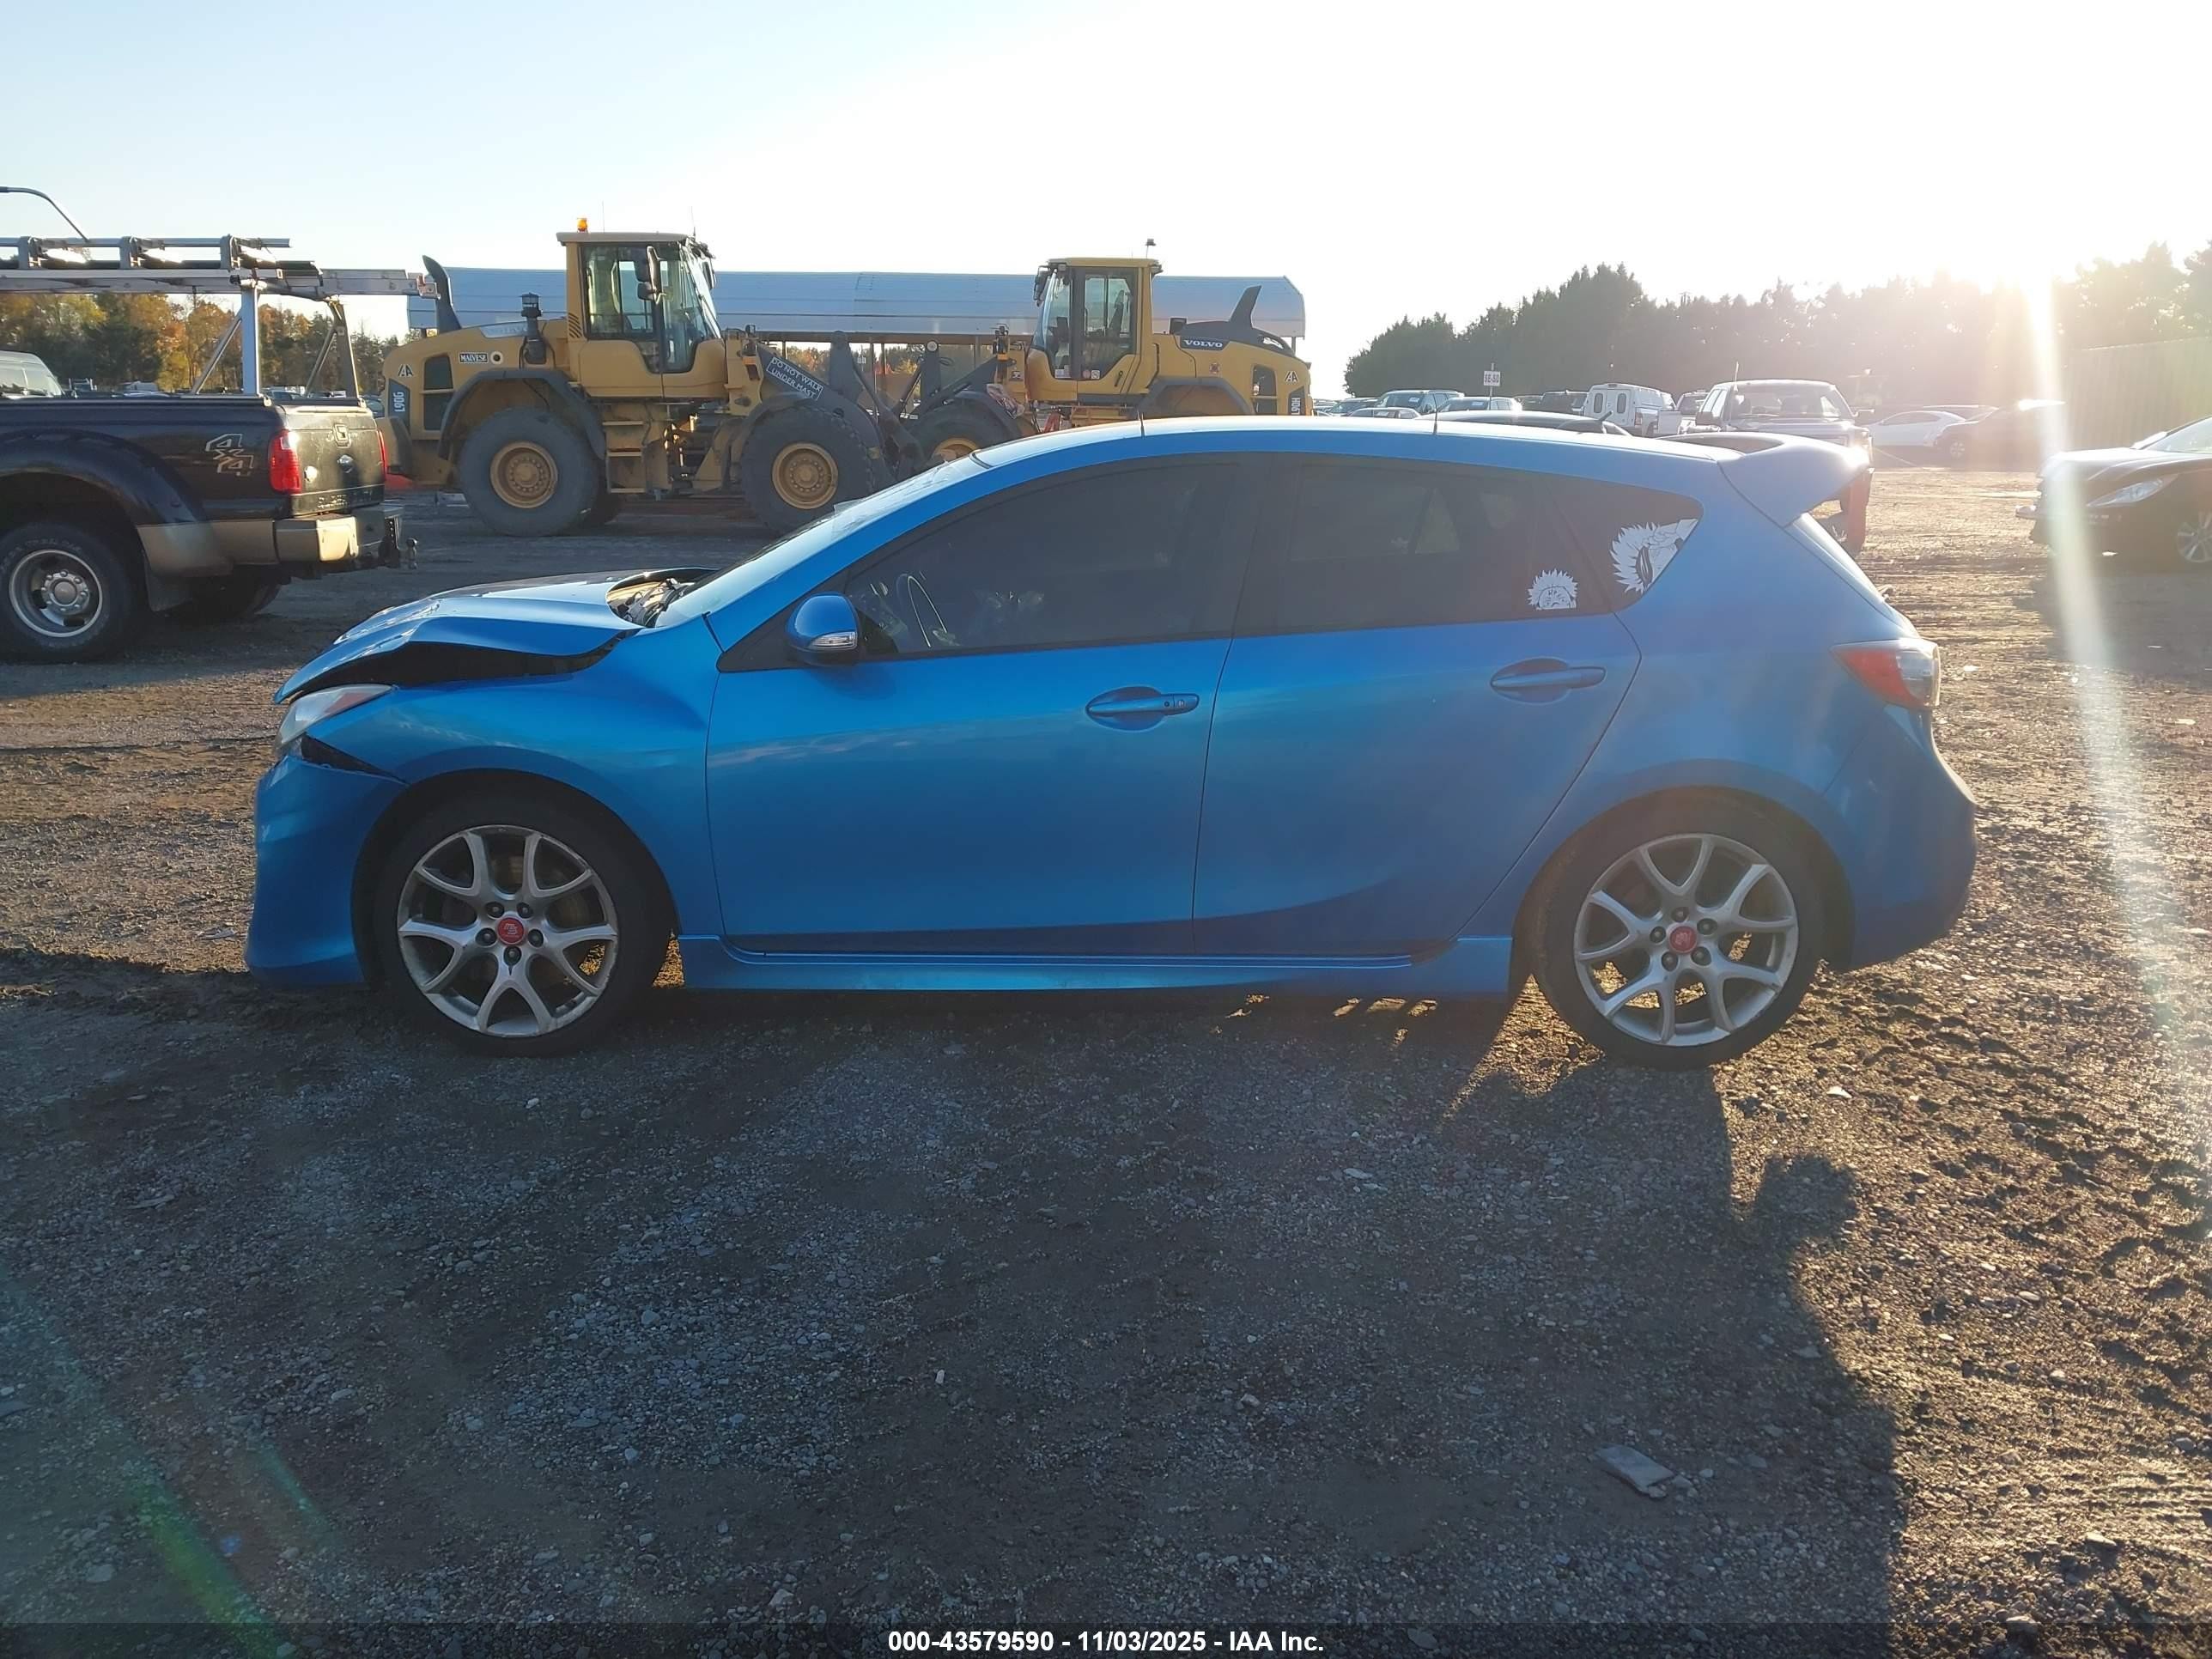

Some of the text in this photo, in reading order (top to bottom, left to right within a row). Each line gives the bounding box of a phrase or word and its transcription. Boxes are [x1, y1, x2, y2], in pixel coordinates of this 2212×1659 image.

[1183, 339, 1223, 348] VOLVO
[772, 357, 821, 392] DO NOT WALK
[772, 368, 817, 399] UNDER MAST
[393, 392, 405, 412] L90G
[1291, 398, 1301, 415] L90H
